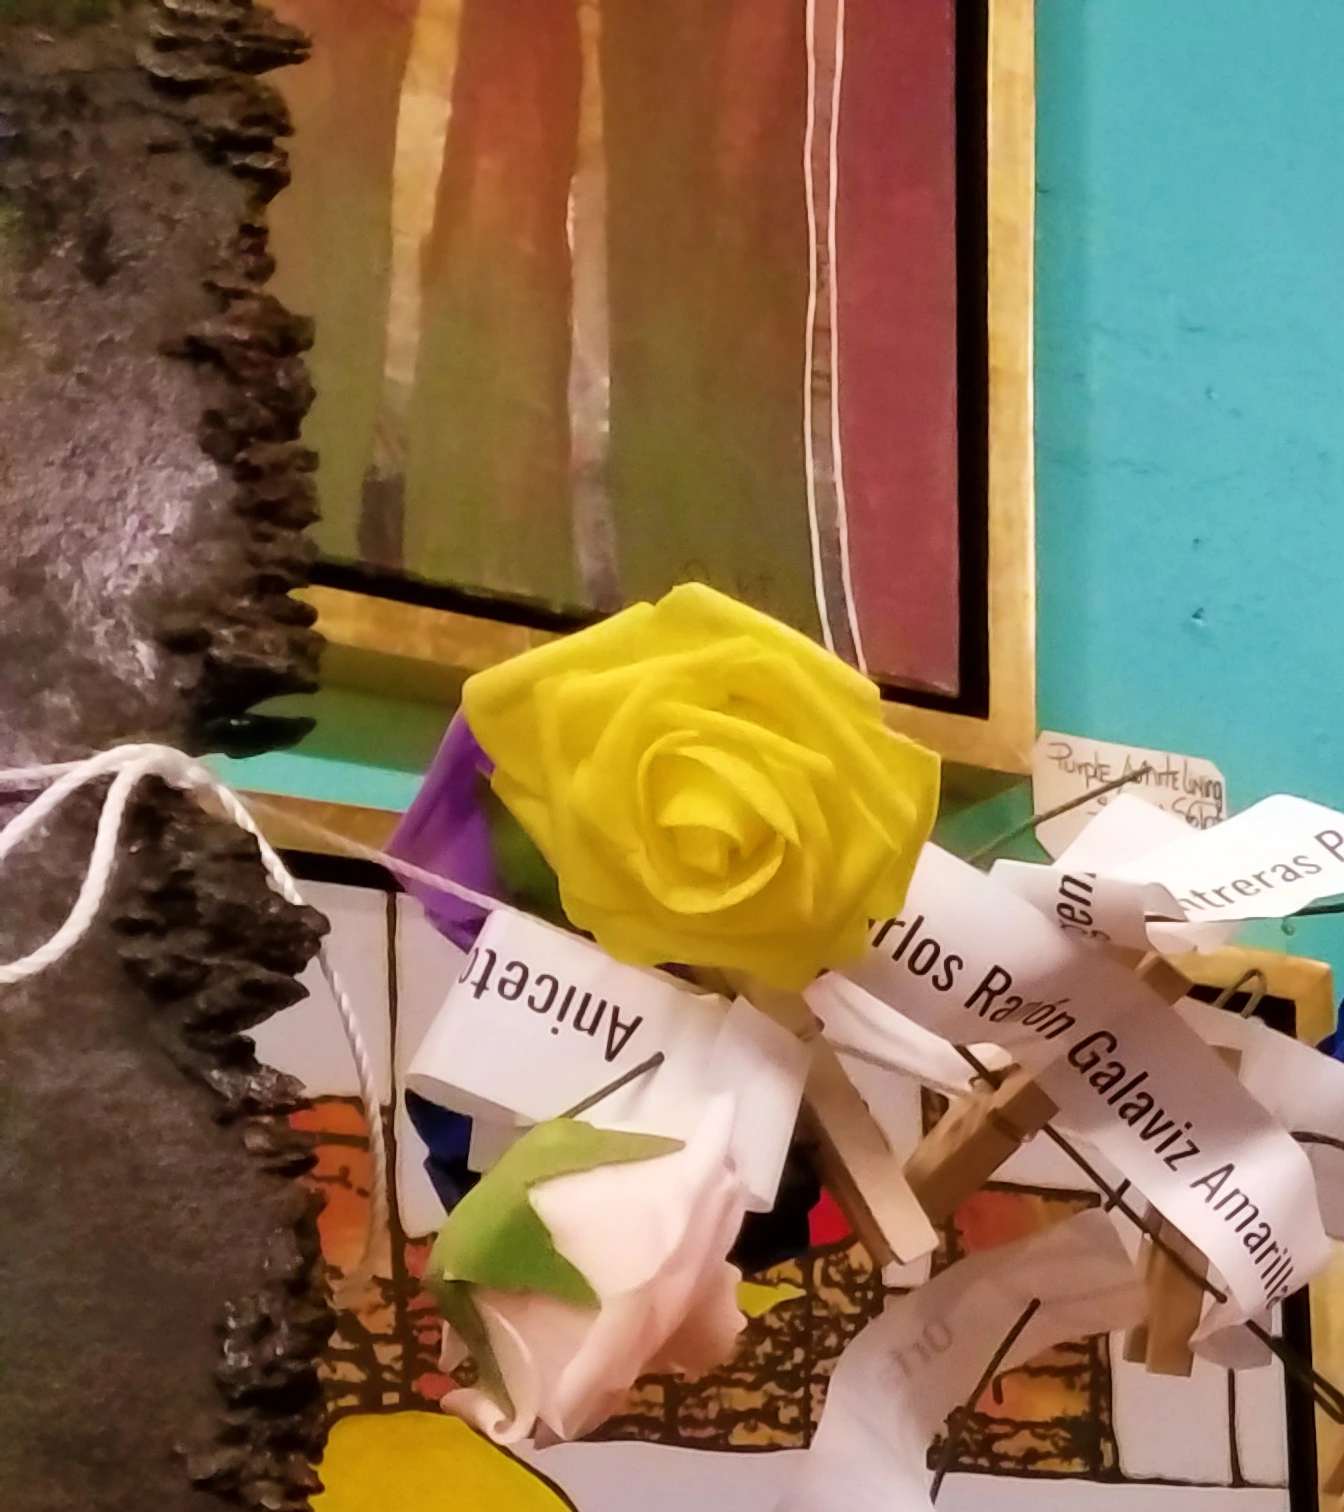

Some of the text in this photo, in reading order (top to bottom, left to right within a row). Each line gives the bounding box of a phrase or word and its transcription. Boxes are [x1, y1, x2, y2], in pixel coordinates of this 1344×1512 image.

[1180, 849, 1323, 917] ntreras
[869, 914, 963, 992] rlos
[963, 965, 1076, 1041] Raón
[1067, 1029, 1200, 1172] Galaviz
